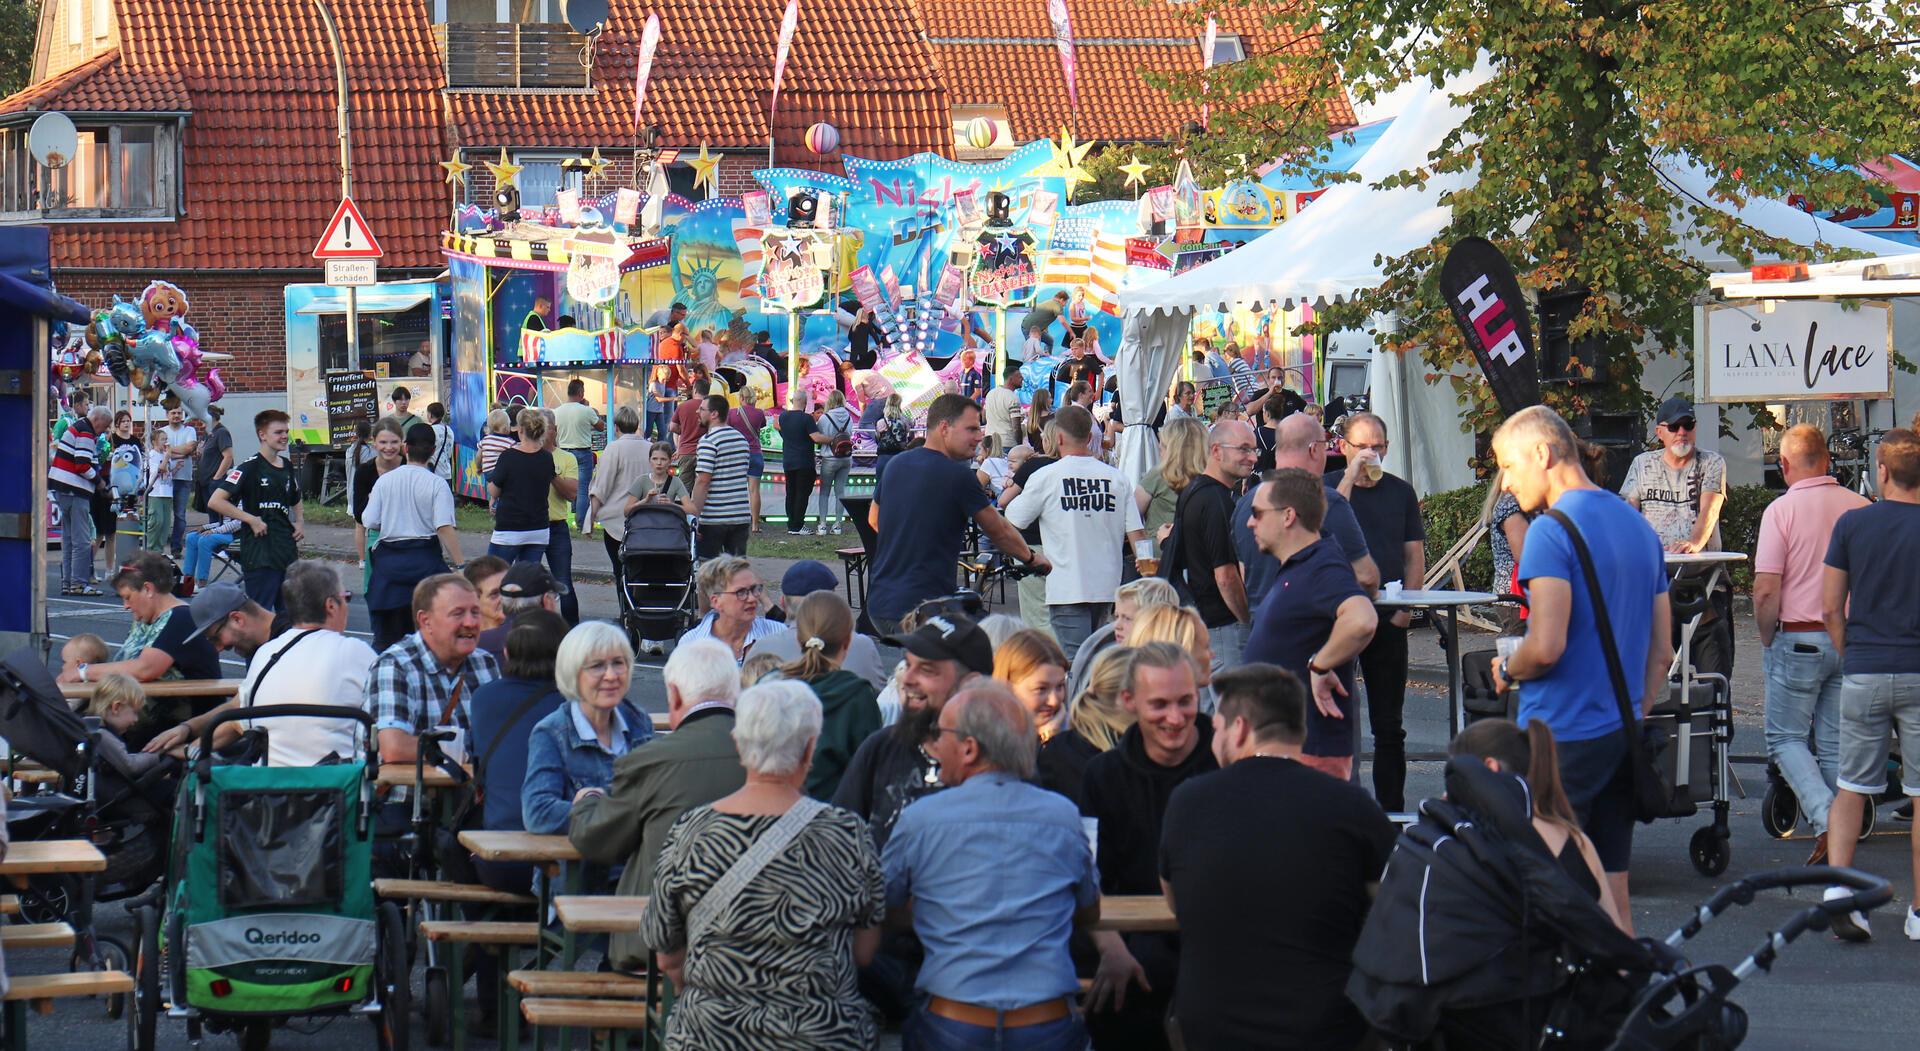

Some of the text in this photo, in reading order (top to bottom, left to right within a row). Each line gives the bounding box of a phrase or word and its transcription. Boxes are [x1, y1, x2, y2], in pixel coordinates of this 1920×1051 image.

[1457, 273, 1526, 367] HUP
[1723, 321, 1874, 389] LANA lace
[328, 373, 364, 383] Erntefest
[332, 380, 375, 393] Hepstedt
[331, 405, 353, 415] 28.9.
[1062, 477, 1112, 496] NEXT
[1060, 493, 1116, 512] WAVE
[244, 927, 321, 945] Qeridoo
